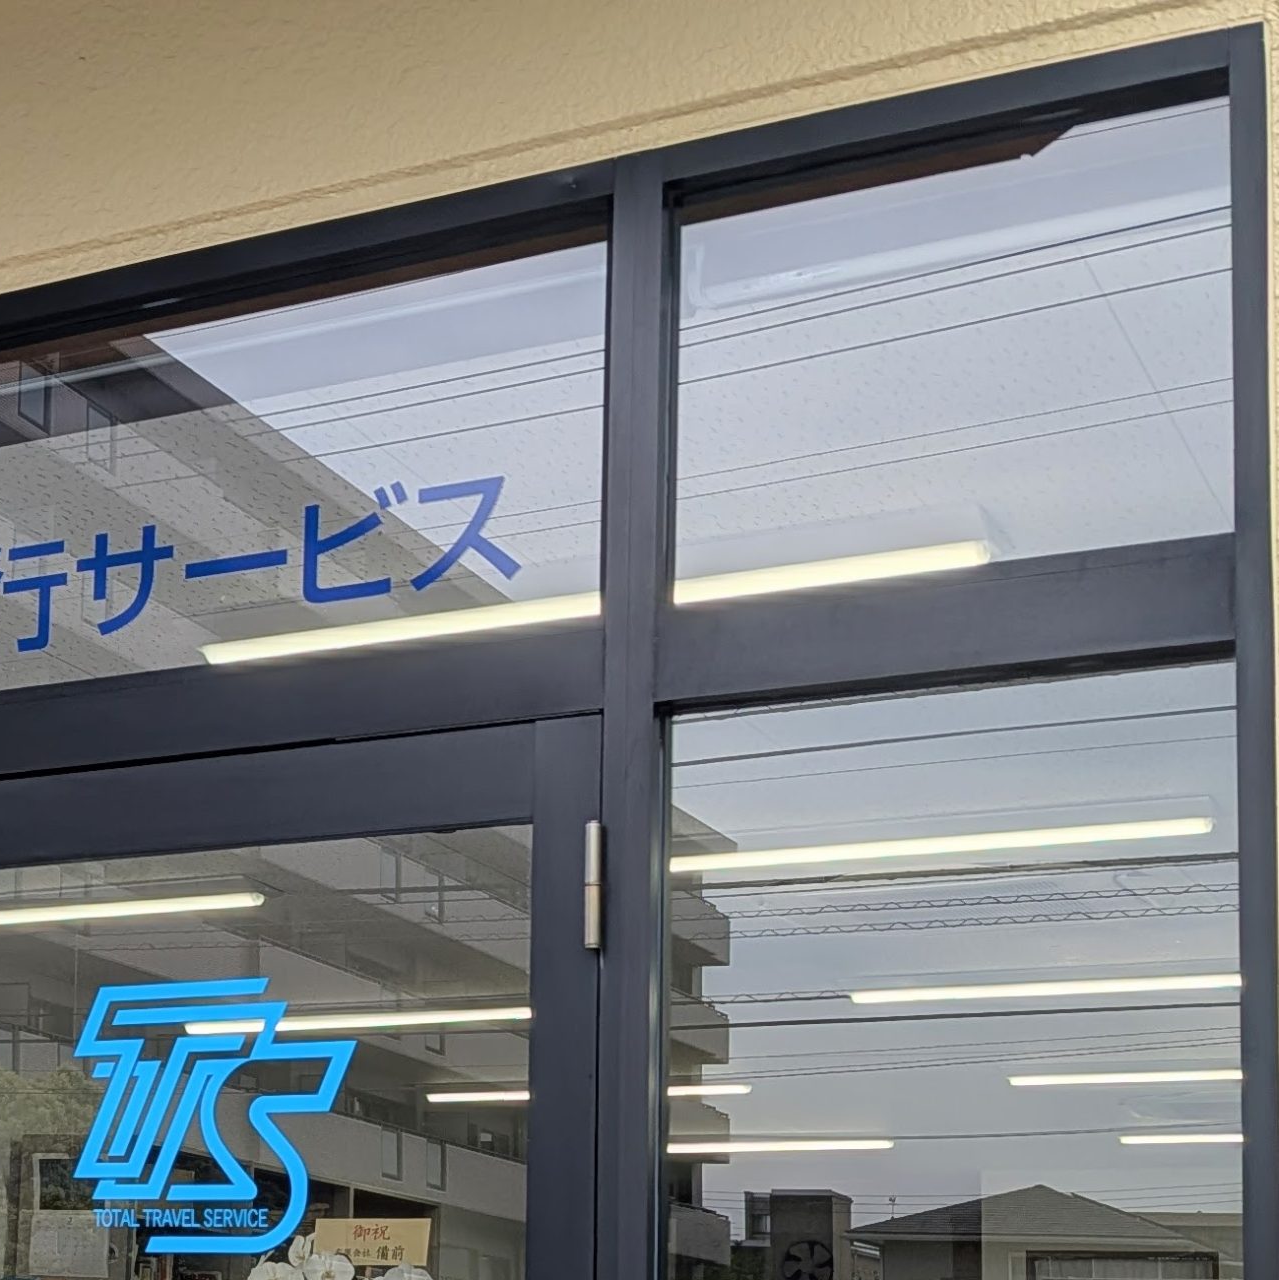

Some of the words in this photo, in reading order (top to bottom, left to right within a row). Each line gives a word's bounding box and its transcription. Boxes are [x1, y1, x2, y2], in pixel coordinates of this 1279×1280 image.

[93, 1207, 141, 1228] TOTAL
[143, 1207, 201, 1228] TRAVEL
[203, 1207, 269, 1228] SERVICE
[353, 1224, 391, 1242] 御祝
